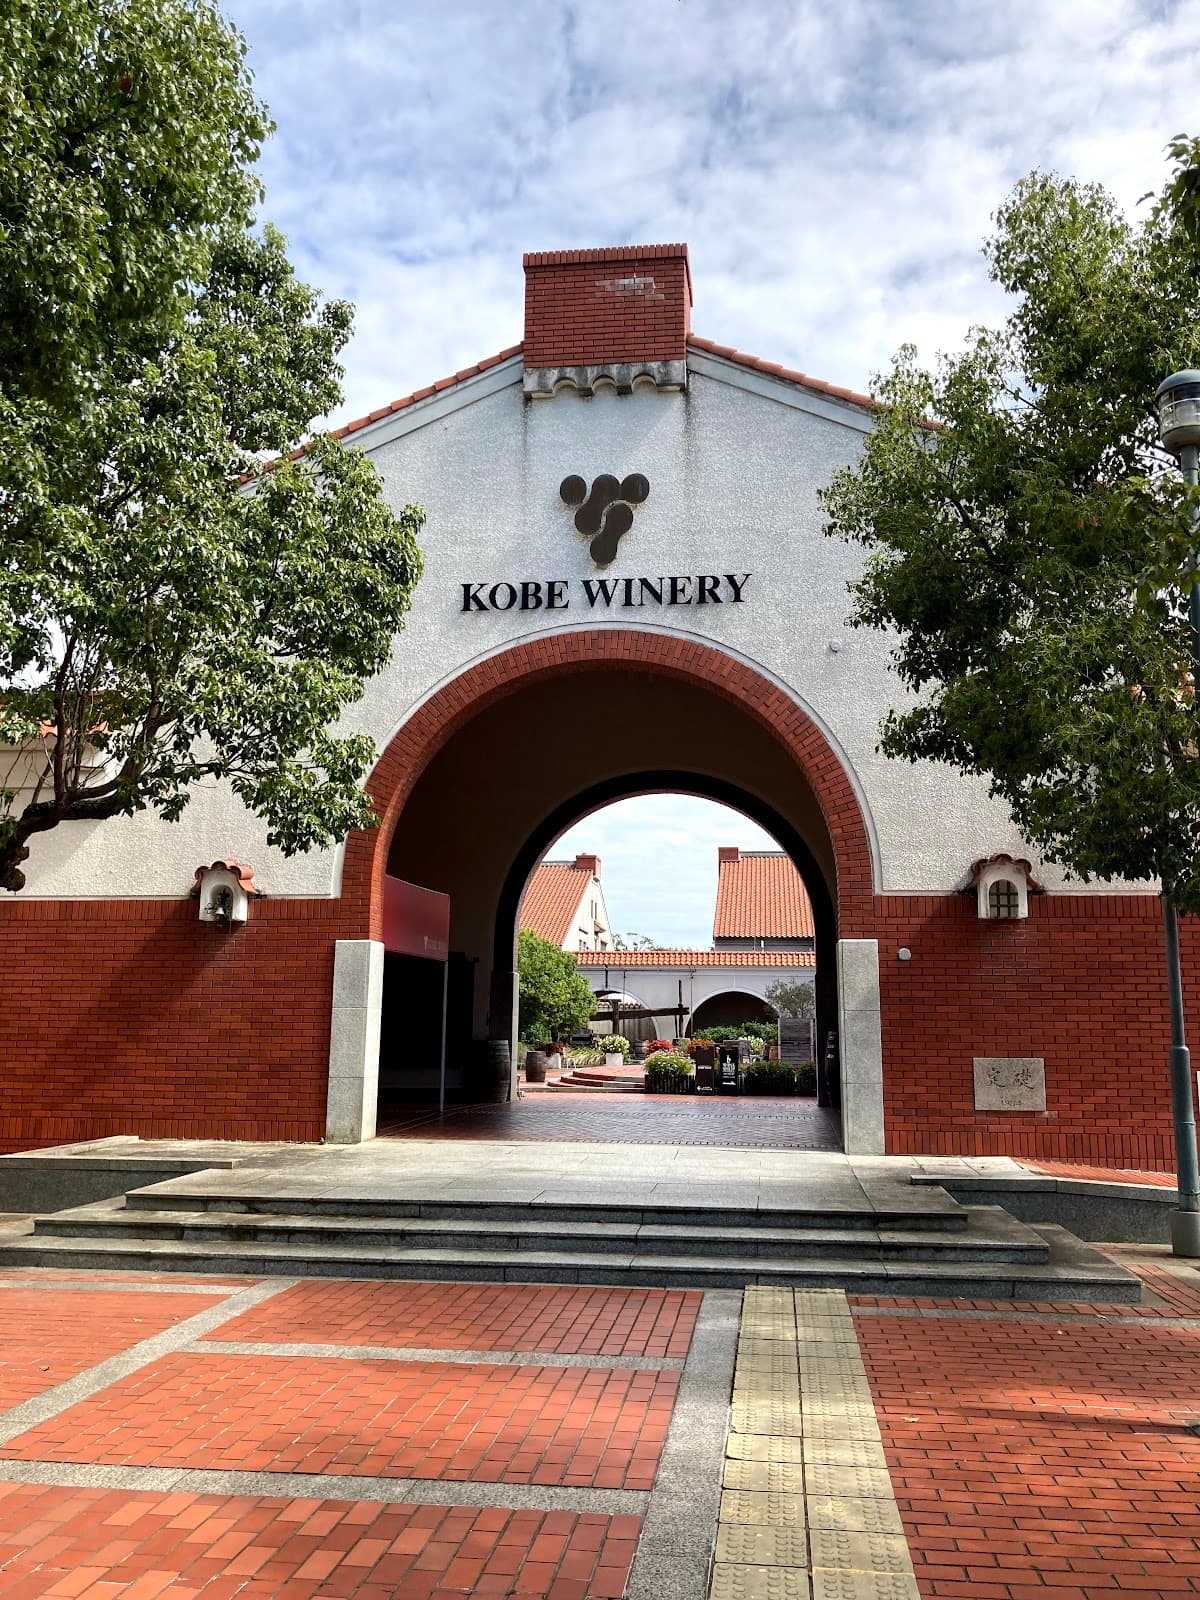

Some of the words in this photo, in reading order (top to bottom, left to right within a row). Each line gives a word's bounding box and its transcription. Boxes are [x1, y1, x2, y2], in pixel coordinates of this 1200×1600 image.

[461, 581, 570, 612] KOBE
[581, 573, 753, 608] WINERY
[984, 1067, 1035, 1090] 定礎
